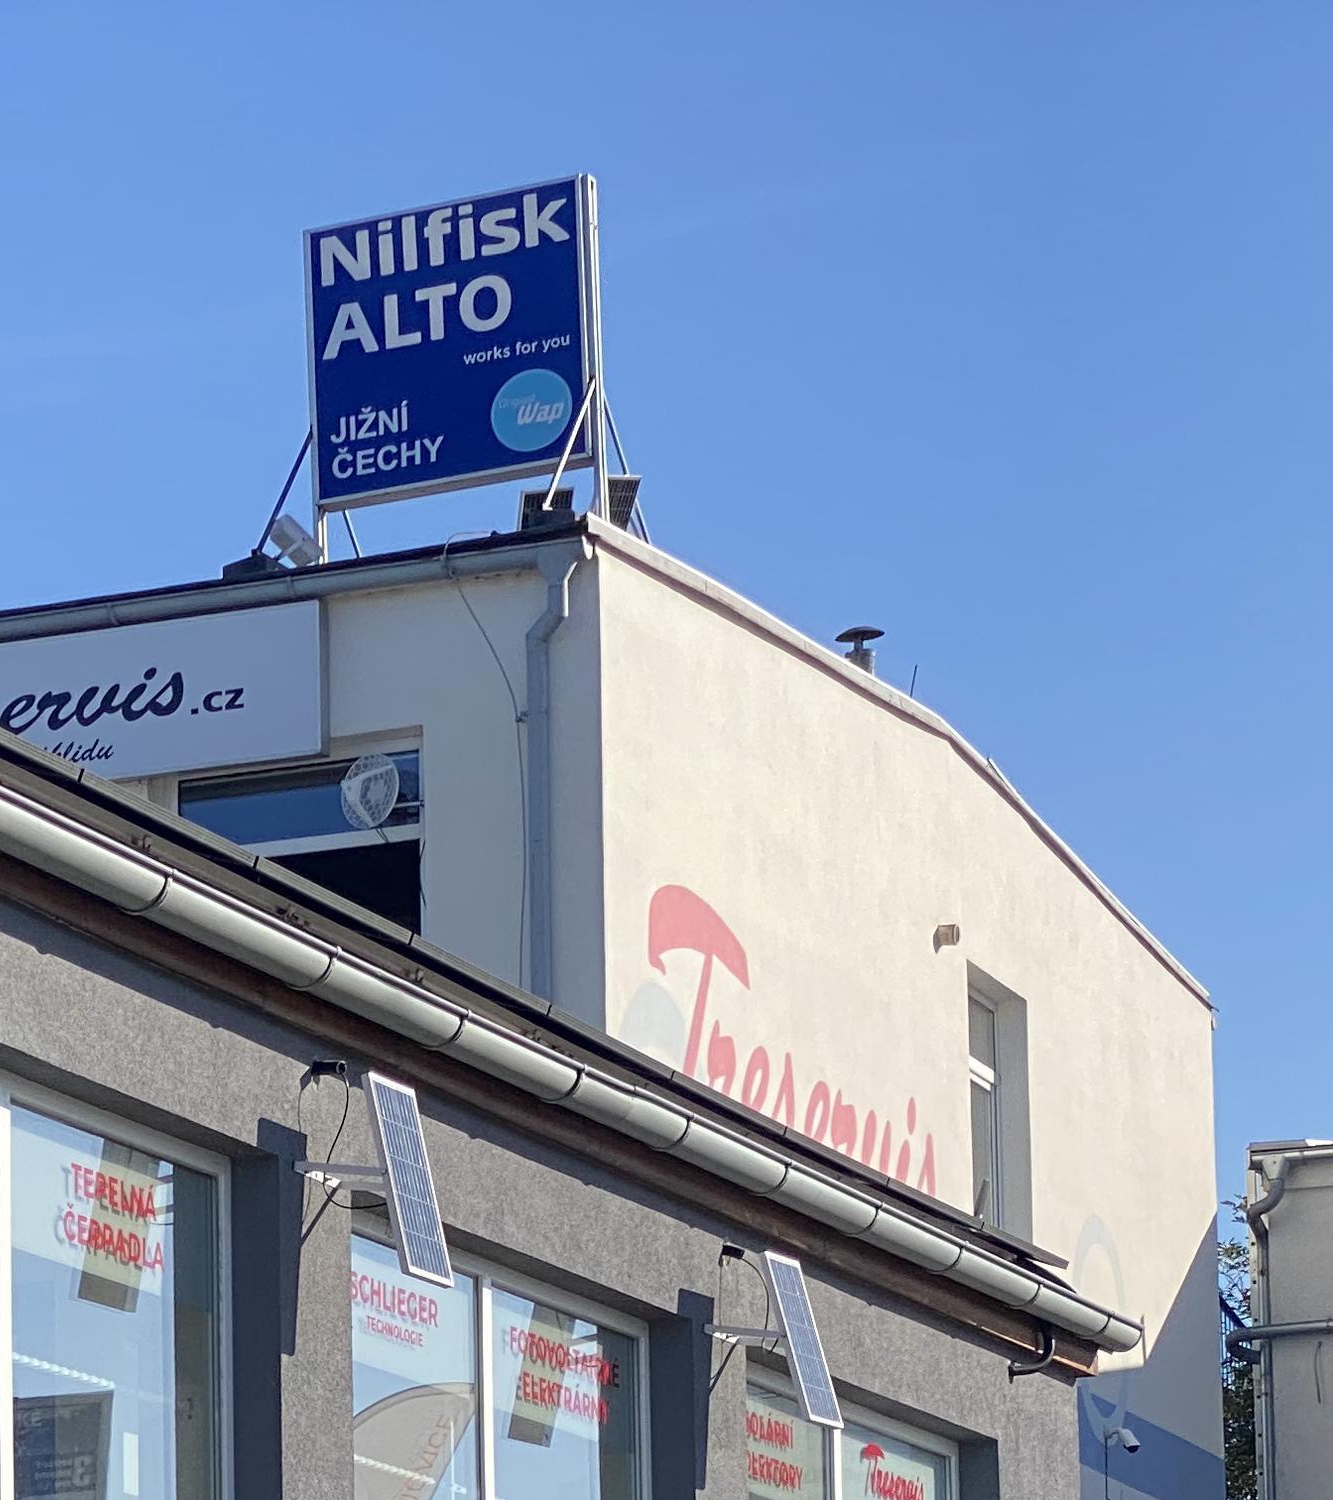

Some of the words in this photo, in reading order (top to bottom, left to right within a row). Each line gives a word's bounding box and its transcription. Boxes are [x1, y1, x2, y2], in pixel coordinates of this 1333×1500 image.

[319, 193, 570, 287] Nilfisk
[322, 274, 512, 360] ALTO
[463, 345, 510, 365] works
[515, 340, 538, 356] for
[542, 334, 571, 355] you
[330, 400, 409, 443] JIŽNÍ
[517, 402, 565, 425] Wap
[331, 435, 445, 480] ČECHY
